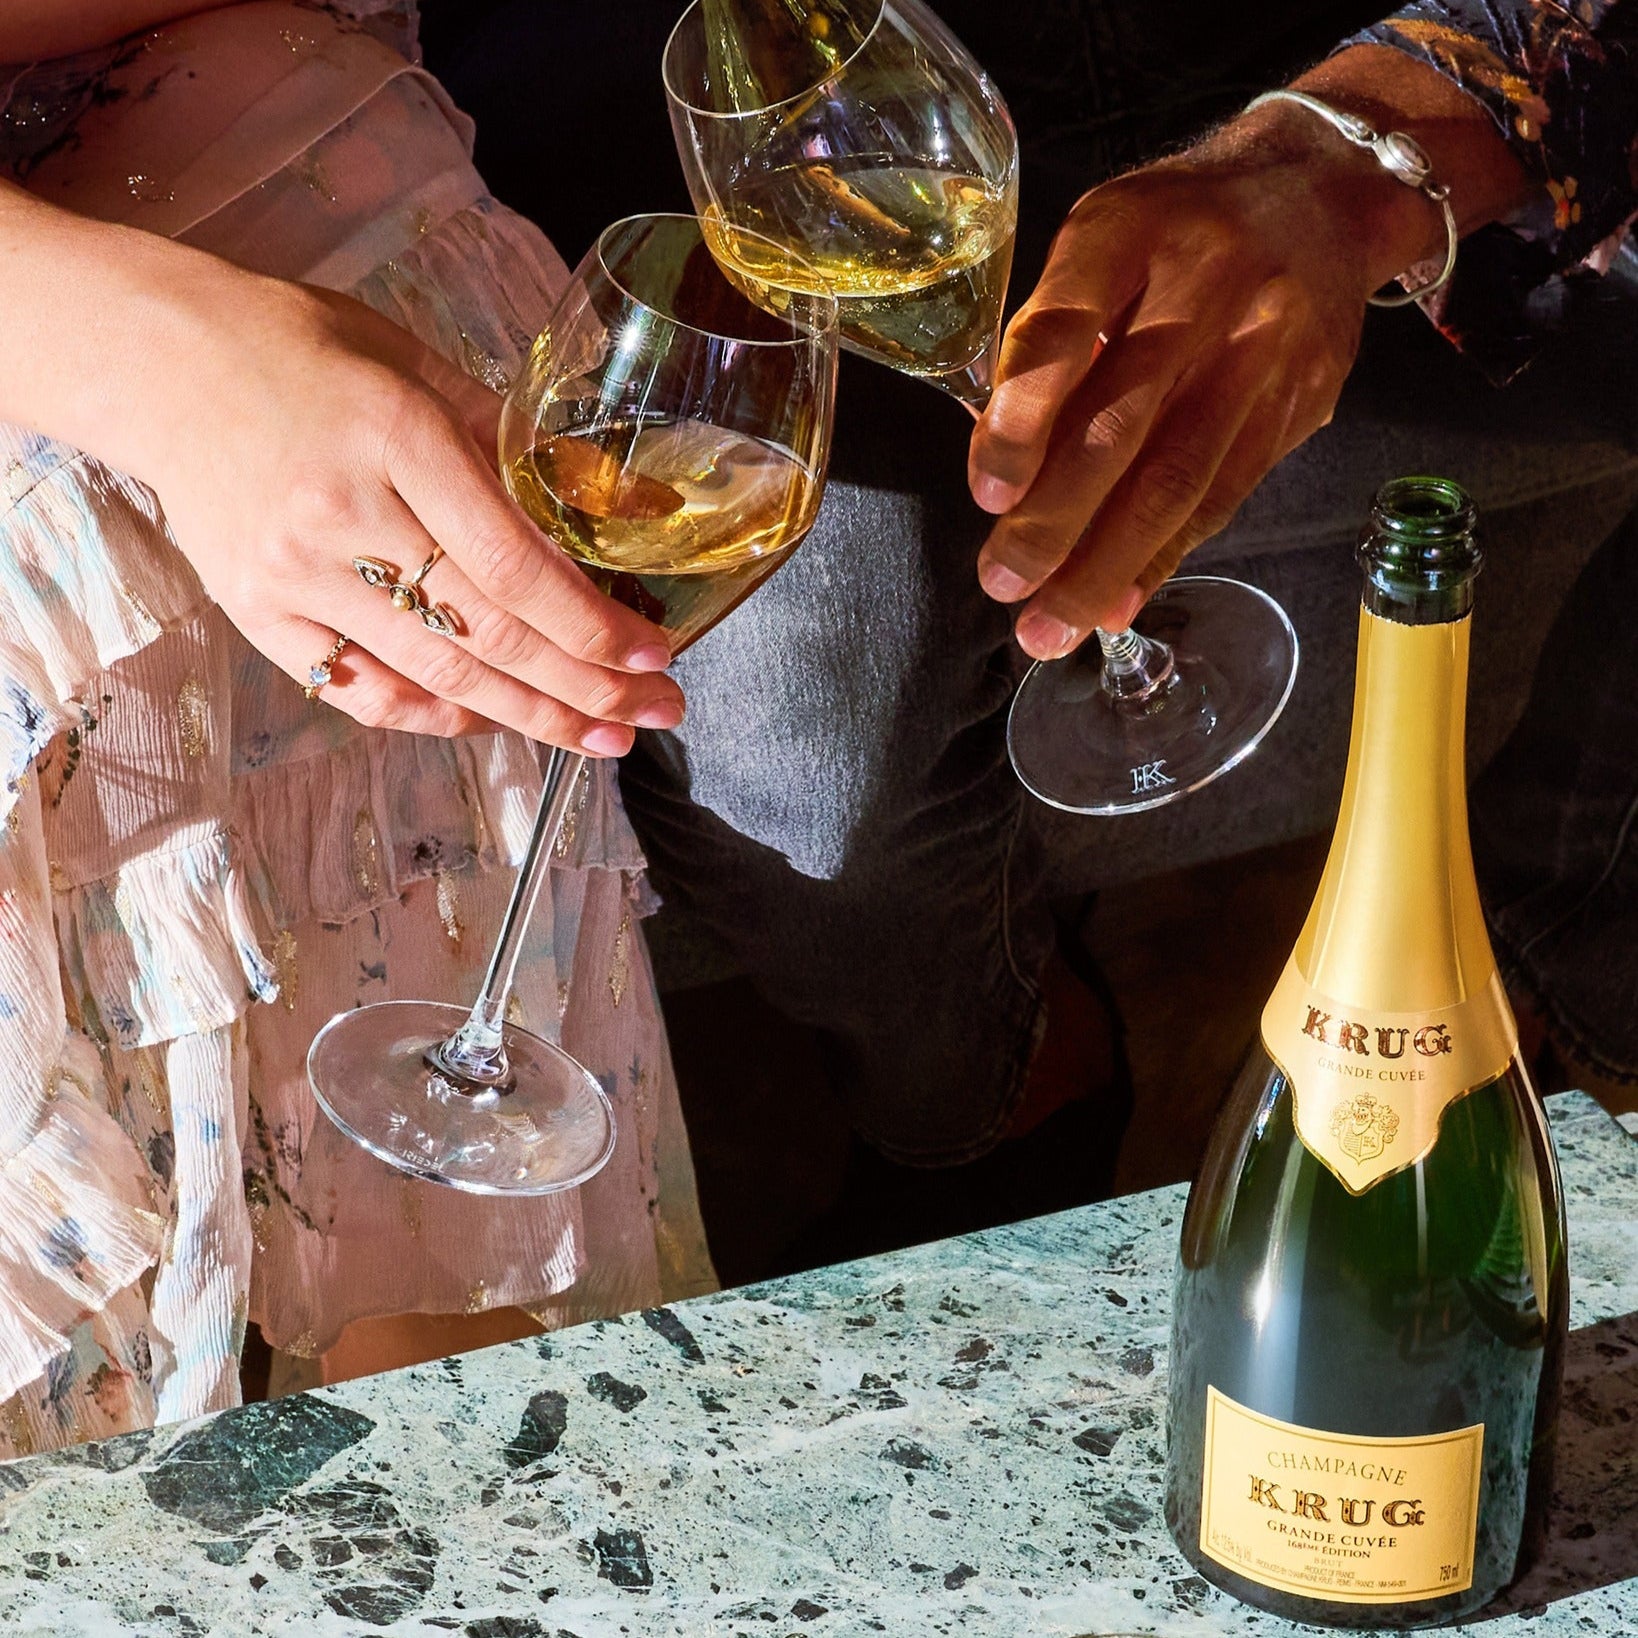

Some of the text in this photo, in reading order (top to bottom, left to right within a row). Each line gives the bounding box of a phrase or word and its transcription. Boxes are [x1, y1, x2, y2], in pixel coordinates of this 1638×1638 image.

[1301, 1004, 1453, 1059] KRUG
[1317, 1056, 1426, 1082] GRANDE CUVÉE
[1267, 1451, 1407, 1486] CHAMPAGNE
[1248, 1474, 1426, 1527] KRUG
[1267, 1519, 1398, 1548] GRANDE CUVÉE
[1322, 1545, 1371, 1559] ÉDITION
[1439, 1564, 1451, 1582] 750
